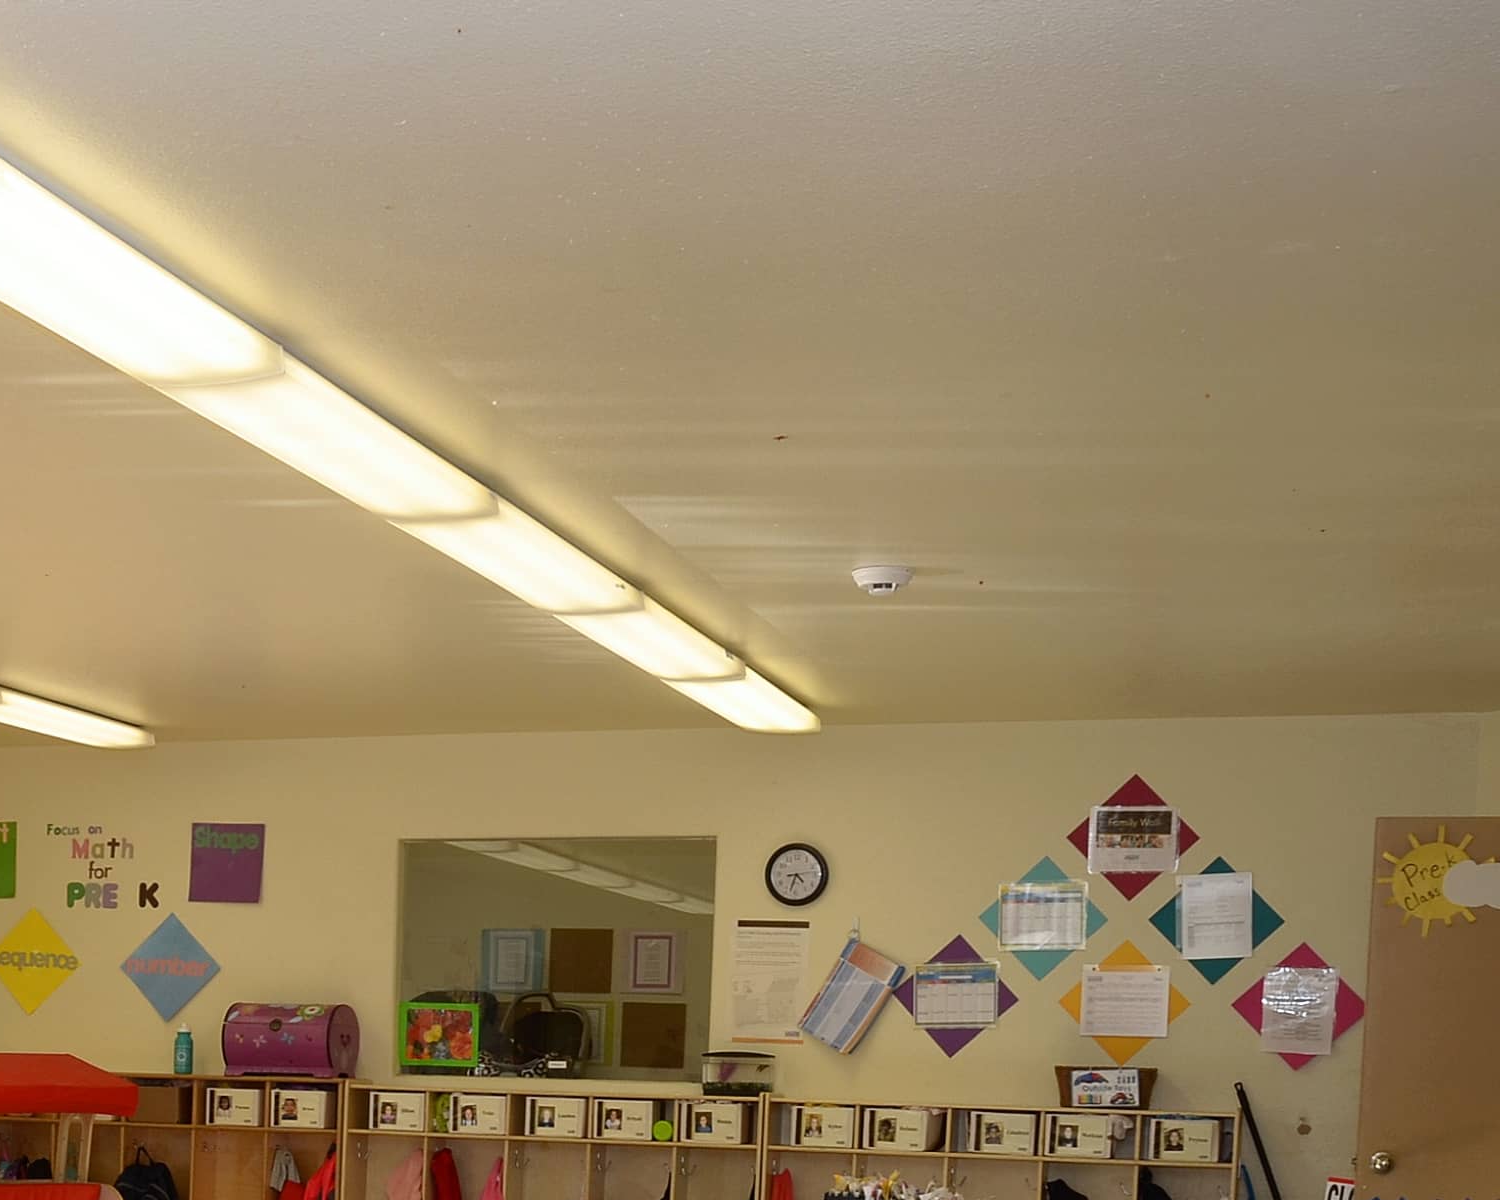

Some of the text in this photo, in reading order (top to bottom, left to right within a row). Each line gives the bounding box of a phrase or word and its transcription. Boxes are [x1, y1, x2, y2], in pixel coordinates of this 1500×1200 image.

[46, 824, 102, 836] Focus on
[193, 826, 260, 854] Shape
[71, 838, 134, 859] Math
[88, 861, 113, 880] for
[67, 882, 160, 909] PRE K
[1404, 888, 1441, 912] Class
[126, 956, 211, 978] number
